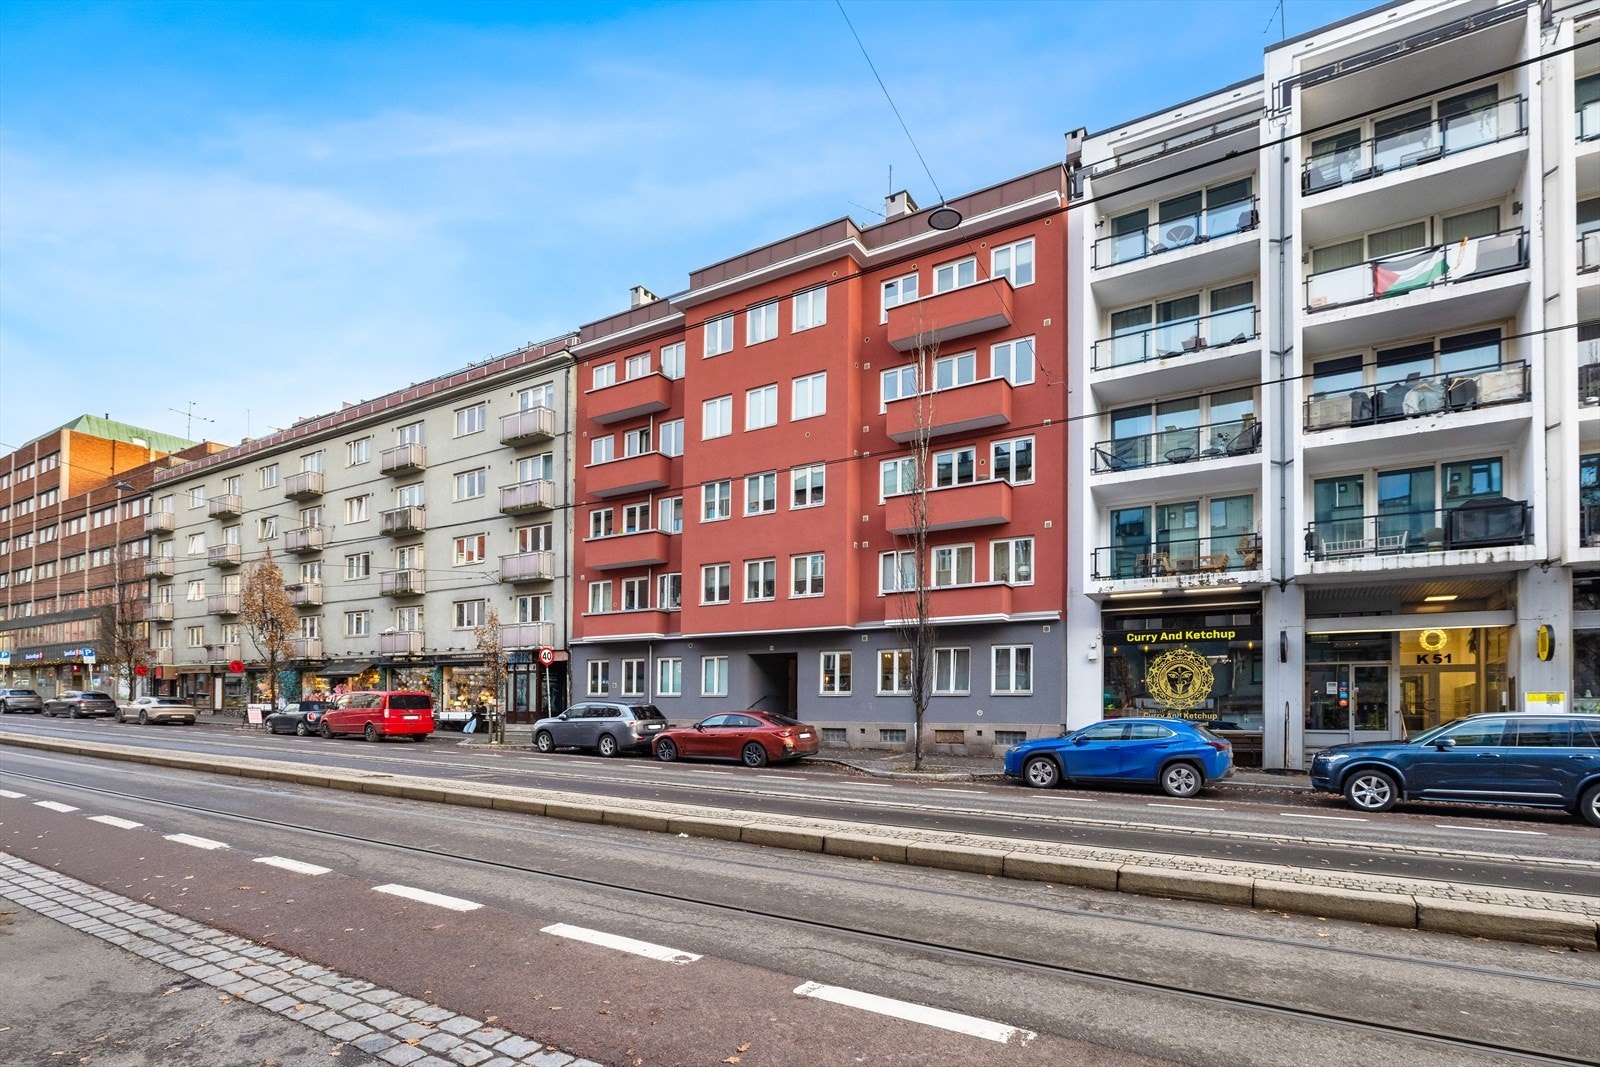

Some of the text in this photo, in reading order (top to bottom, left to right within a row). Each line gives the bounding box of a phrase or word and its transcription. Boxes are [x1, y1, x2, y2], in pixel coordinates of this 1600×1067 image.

[1126, 629, 1236, 643] Curry And Ketchup
[542, 652, 551, 660] 40
[1416, 654, 1452, 664] K 51
[1183, 711, 1218, 720] Ketchup
